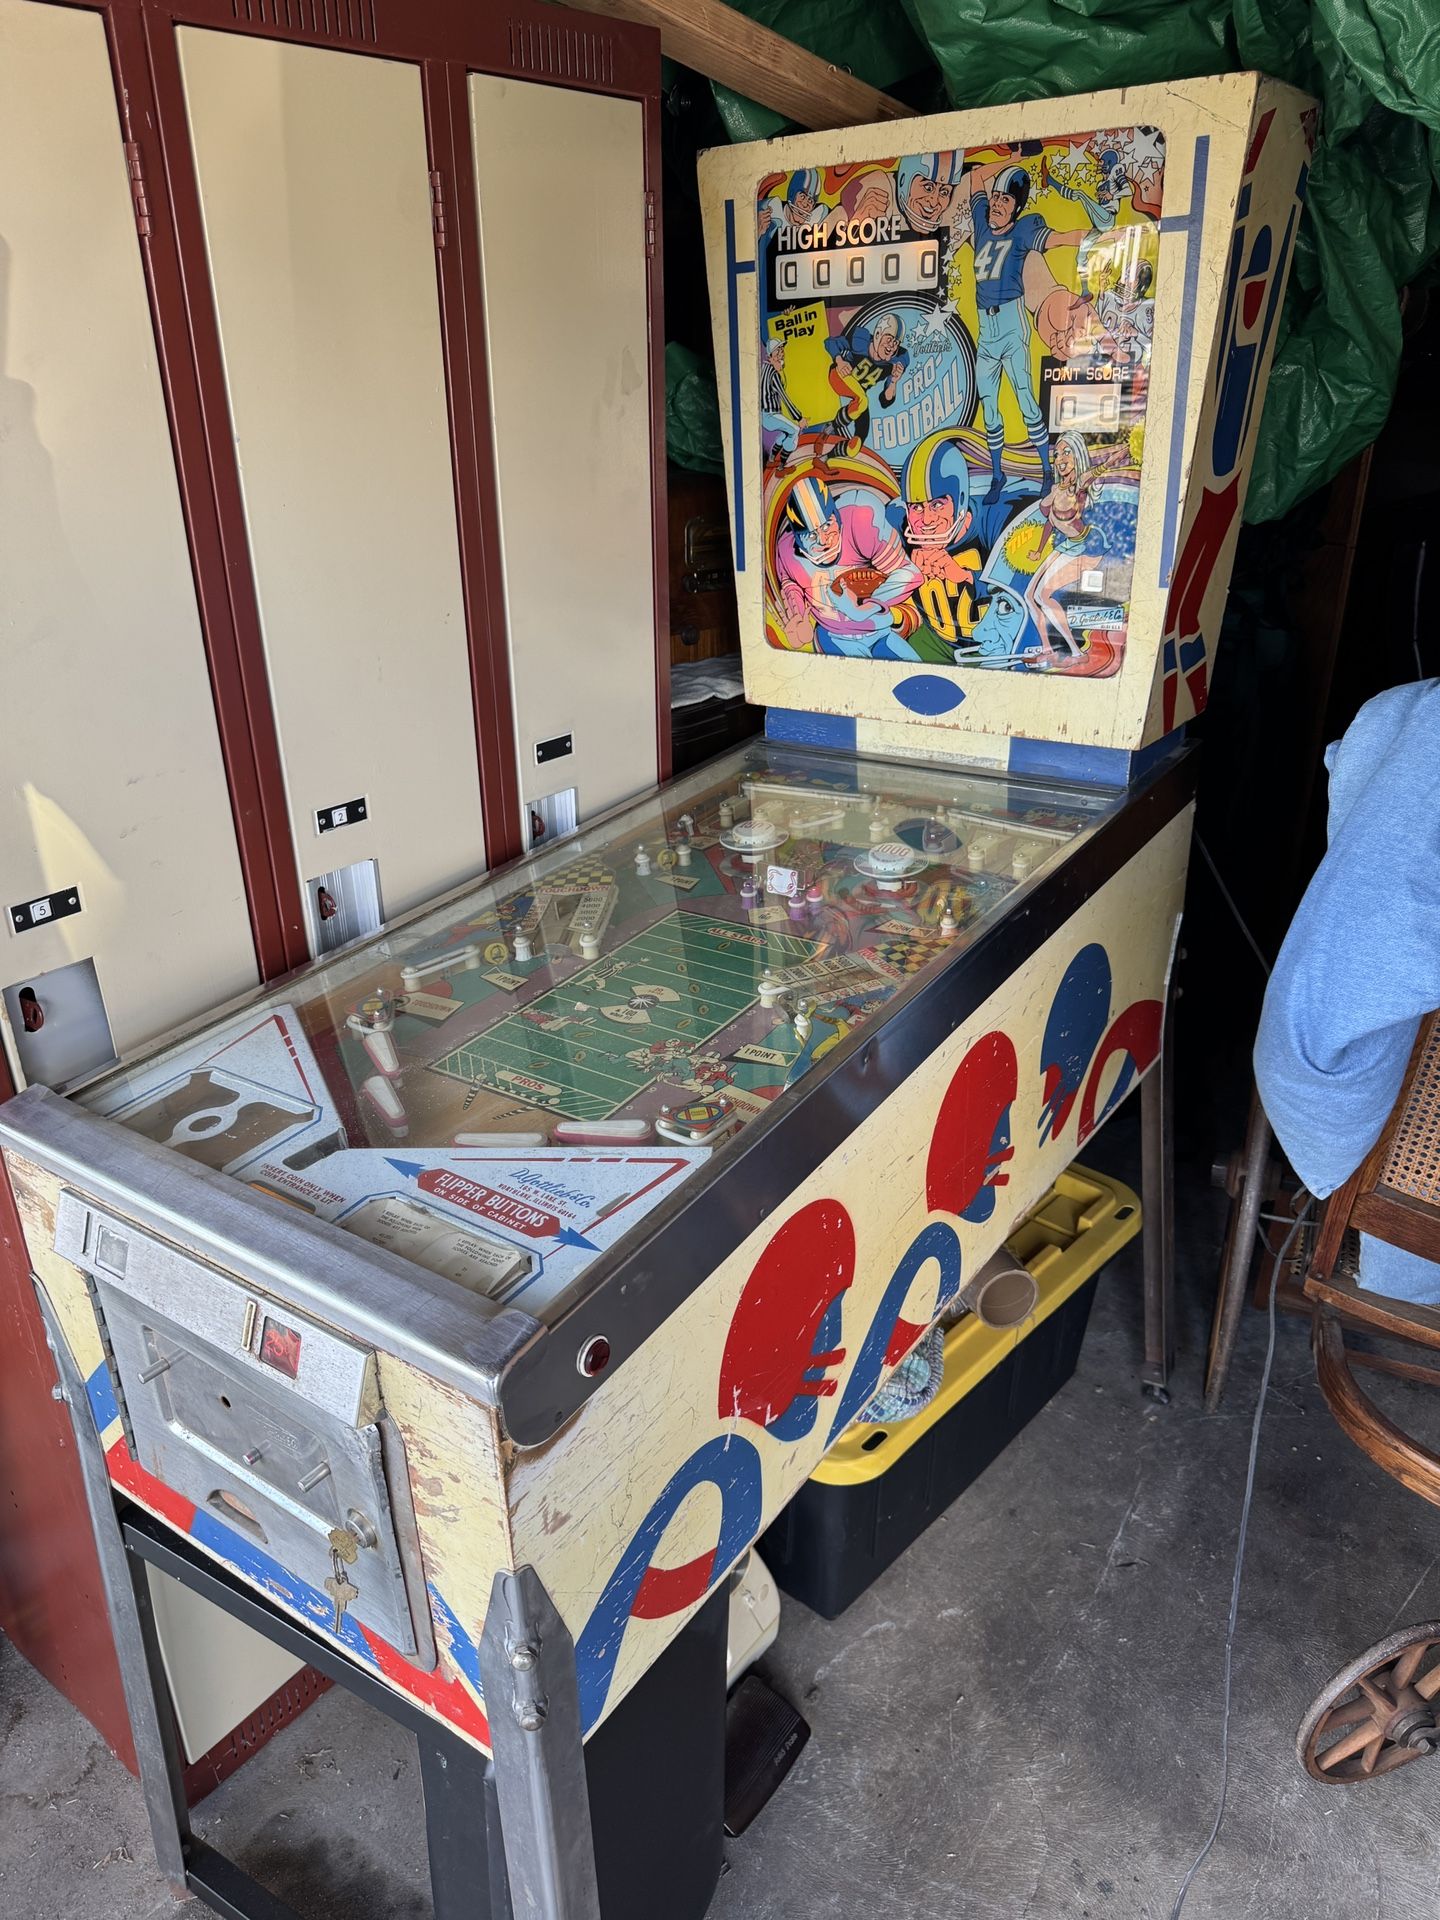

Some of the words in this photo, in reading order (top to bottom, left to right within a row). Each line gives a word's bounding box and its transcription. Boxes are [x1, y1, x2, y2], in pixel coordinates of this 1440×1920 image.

[778, 222, 827, 251] HIGH
[835, 216, 900, 246] SCORE
[974, 240, 1013, 282] 47
[775, 313, 802, 331] Ball
[804, 310, 817, 322] in
[784, 325, 814, 340] Play
[852, 358, 883, 389] 54
[1044, 367, 1080, 381] POINT
[1086, 366, 1129, 381] SCORE
[872, 356, 965, 450] FOOTBALL
[1008, 528, 1034, 554] TILT
[338, 813, 344, 821] 2
[539, 885, 610, 893] TOUCHDOWN
[39, 906, 46, 916] 5
[749, 1049, 777, 1060] POINT
[511, 1075, 546, 1090] PROS
[260, 1163, 288, 1176] INSERT
[286, 1174, 305, 1184] COIN
[304, 1181, 324, 1192] ONLY
[323, 1190, 346, 1203] WHEN
[260, 1169, 279, 1180] COIN
[279, 1177, 314, 1197] ENTRANCE
[320, 1197, 335, 1205] LIT
[520, 1184, 532, 1192] 165
[541, 1193, 557, 1203] LAKE
[433, 1188, 445, 1196] ON
[449, 1193, 469, 1206] SIDE
[472, 1203, 486, 1212] OF
[488, 1210, 527, 1230] CABINET
[434, 1173, 486, 1202] FLIPPER
[484, 1196, 549, 1228] BUTTONS
[532, 1198, 558, 1212] ILLINOIS
